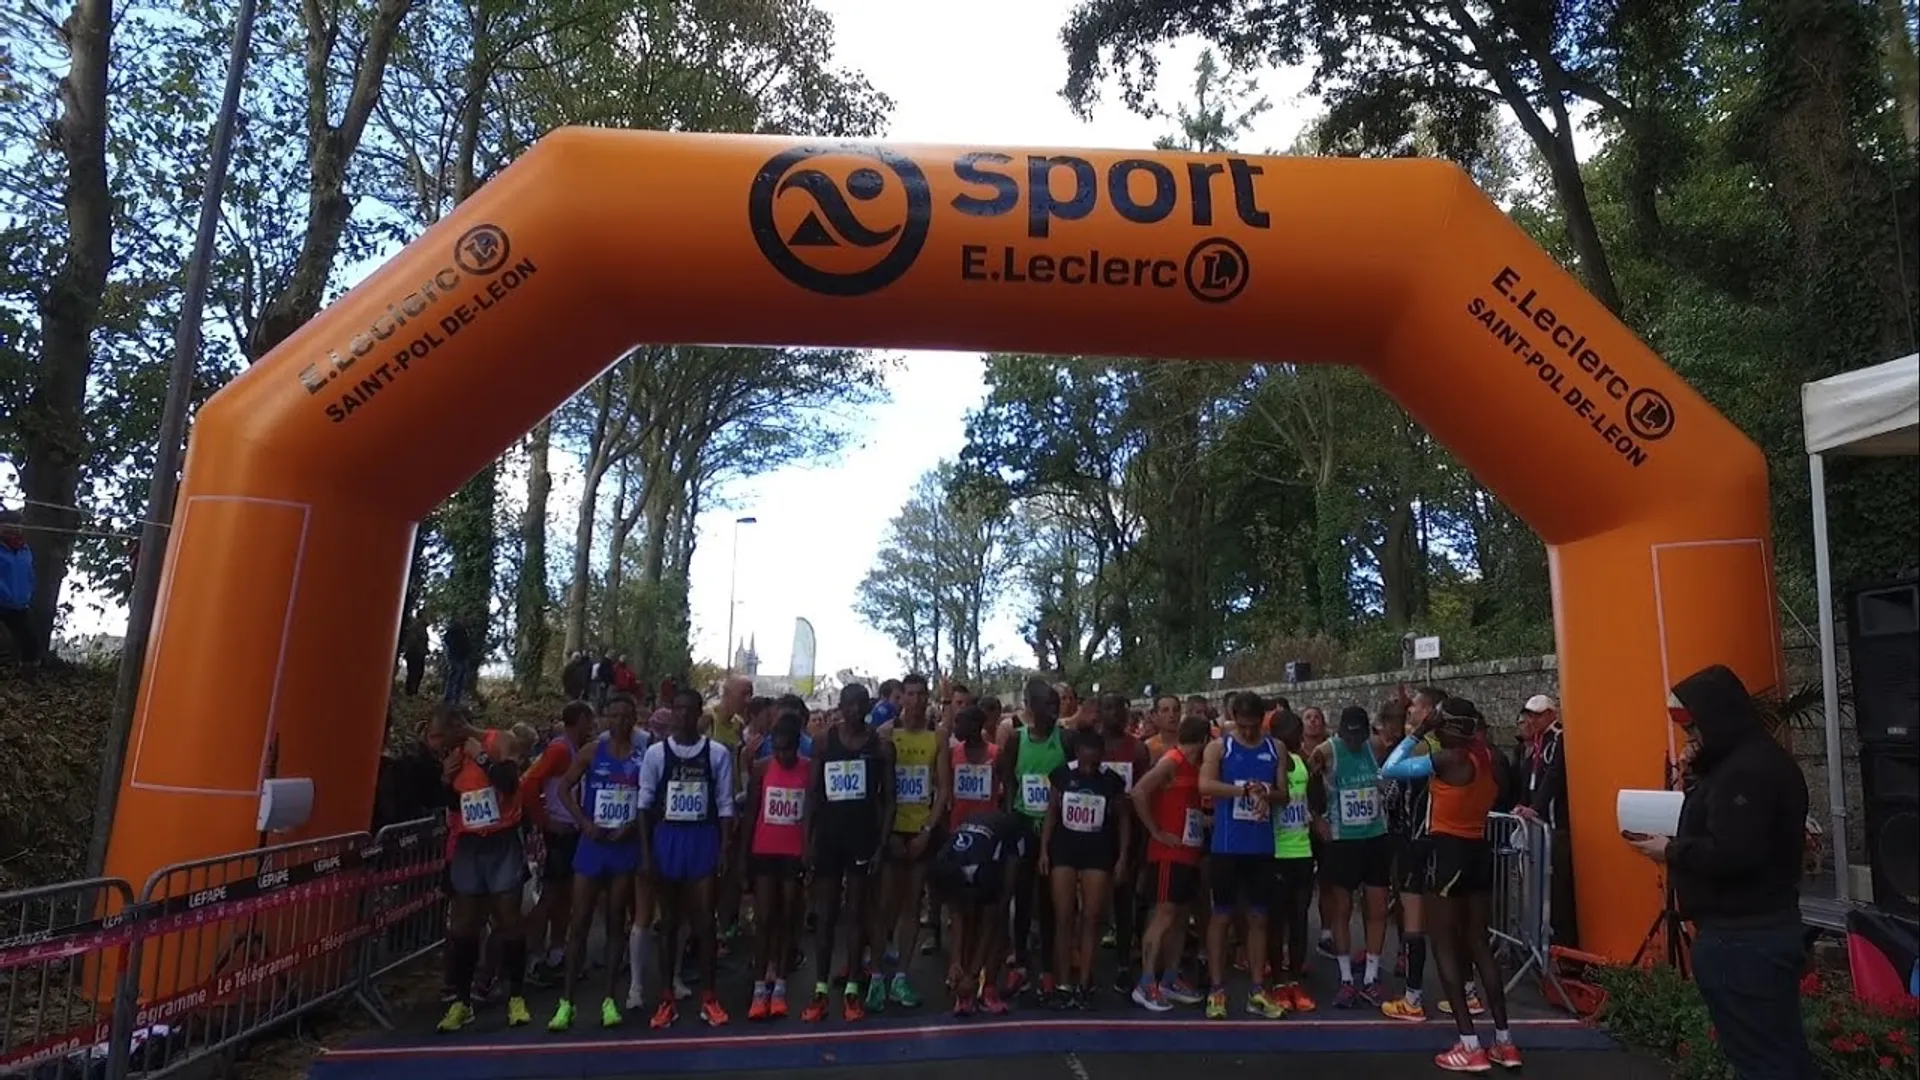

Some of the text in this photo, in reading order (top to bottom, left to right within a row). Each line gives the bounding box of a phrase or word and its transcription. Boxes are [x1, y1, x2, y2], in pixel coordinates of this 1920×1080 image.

[950, 151, 1271, 238] sport
[961, 244, 1178, 290] E.Leclerc
[325, 257, 538, 424] SAINT-POL DE-LEON
[1491, 265, 1630, 401] E.Leclerc
[1467, 297, 1649, 468] SAINT-POL DE-LEON
[829, 773, 860, 792] 3002
[957, 775, 985, 793] 3001
[670, 794, 702, 812] 3006
[1027, 786, 1050, 804] 300
[463, 800, 493, 822] 3004
[600, 802, 631, 820] 3008
[768, 799, 799, 818] 8004
[1066, 805, 1097, 824] 8001
[1345, 800, 1374, 818] 3059
[217, 951, 300, 996] Le Télégramme
[136, 987, 207, 1026] égramme
